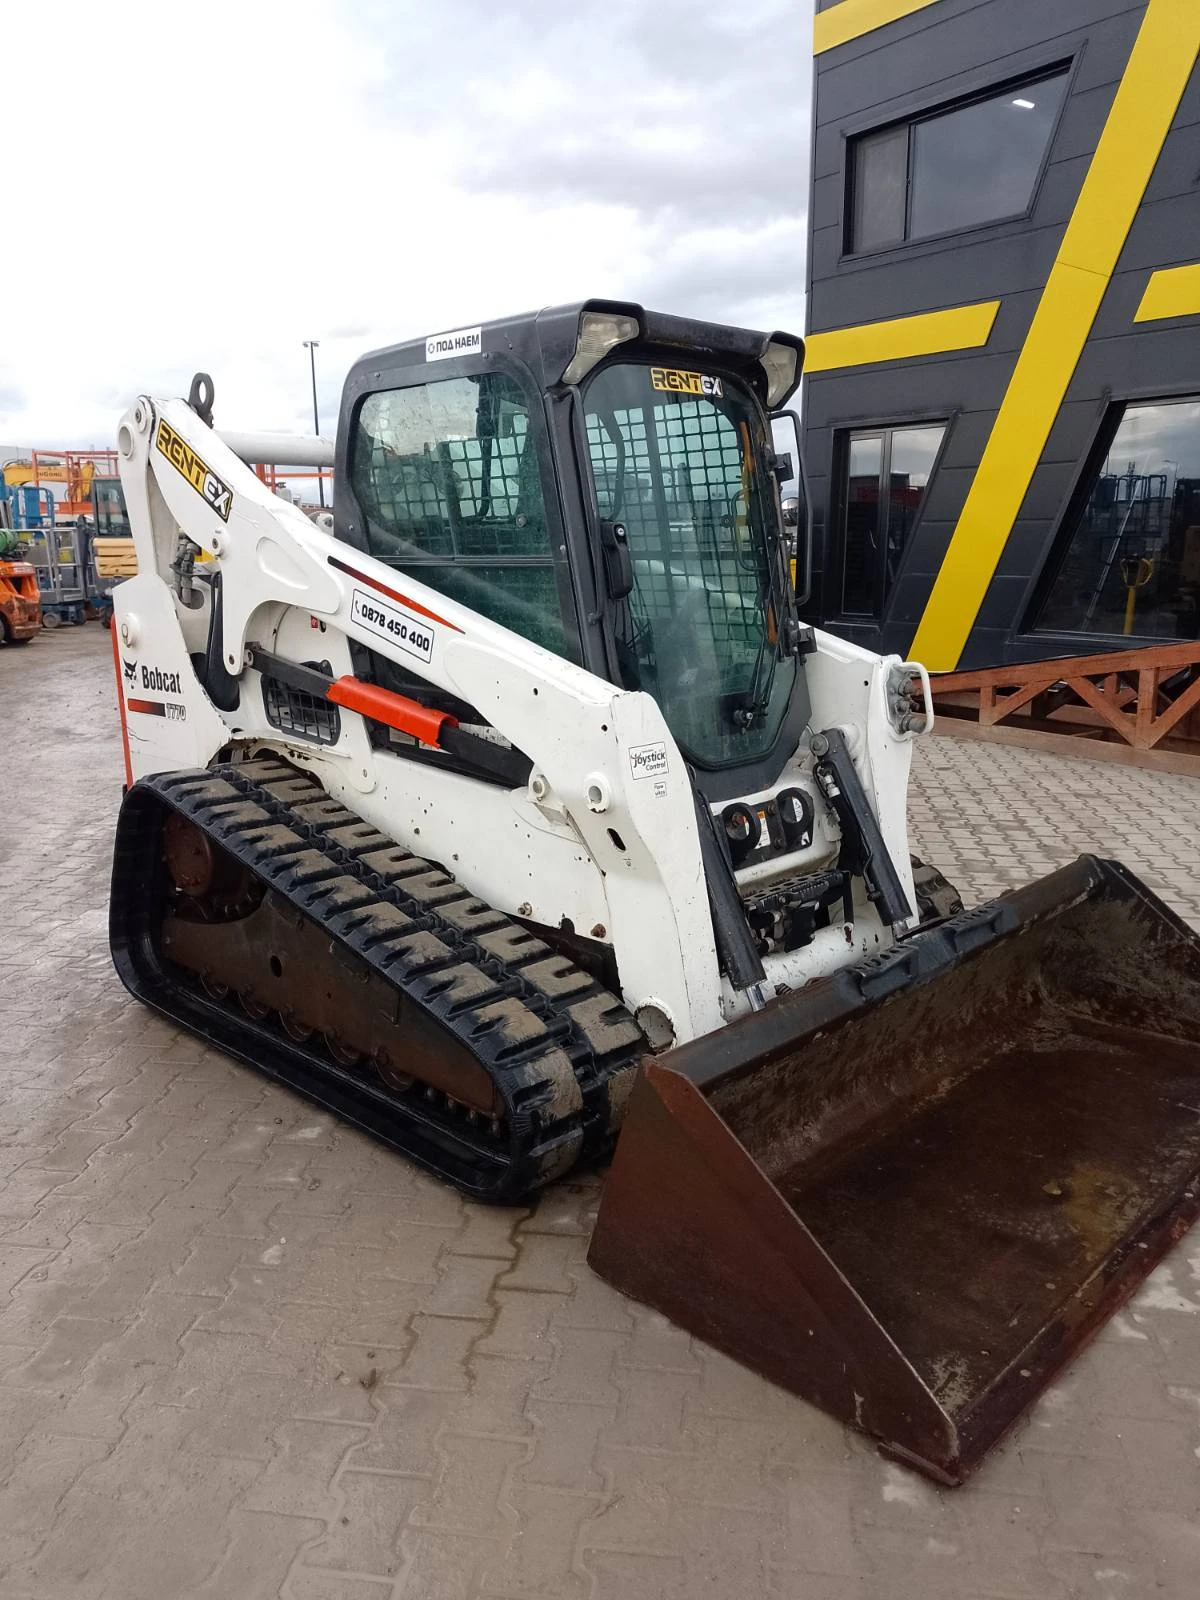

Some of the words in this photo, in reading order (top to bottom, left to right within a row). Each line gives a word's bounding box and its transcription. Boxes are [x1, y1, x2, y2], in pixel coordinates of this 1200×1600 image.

[436, 339, 454, 352] ПОД
[455, 333, 480, 350] НАЕМ
[652, 369, 722, 396] RENTEX
[158, 422, 230, 516] RENTEX
[361, 604, 386, 628] 0878
[386, 619, 407, 640] 450
[408, 631, 430, 652] 400
[141, 665, 182, 694] Bobcat
[166, 703, 187, 721] T770
[645, 761, 666, 771] Control
